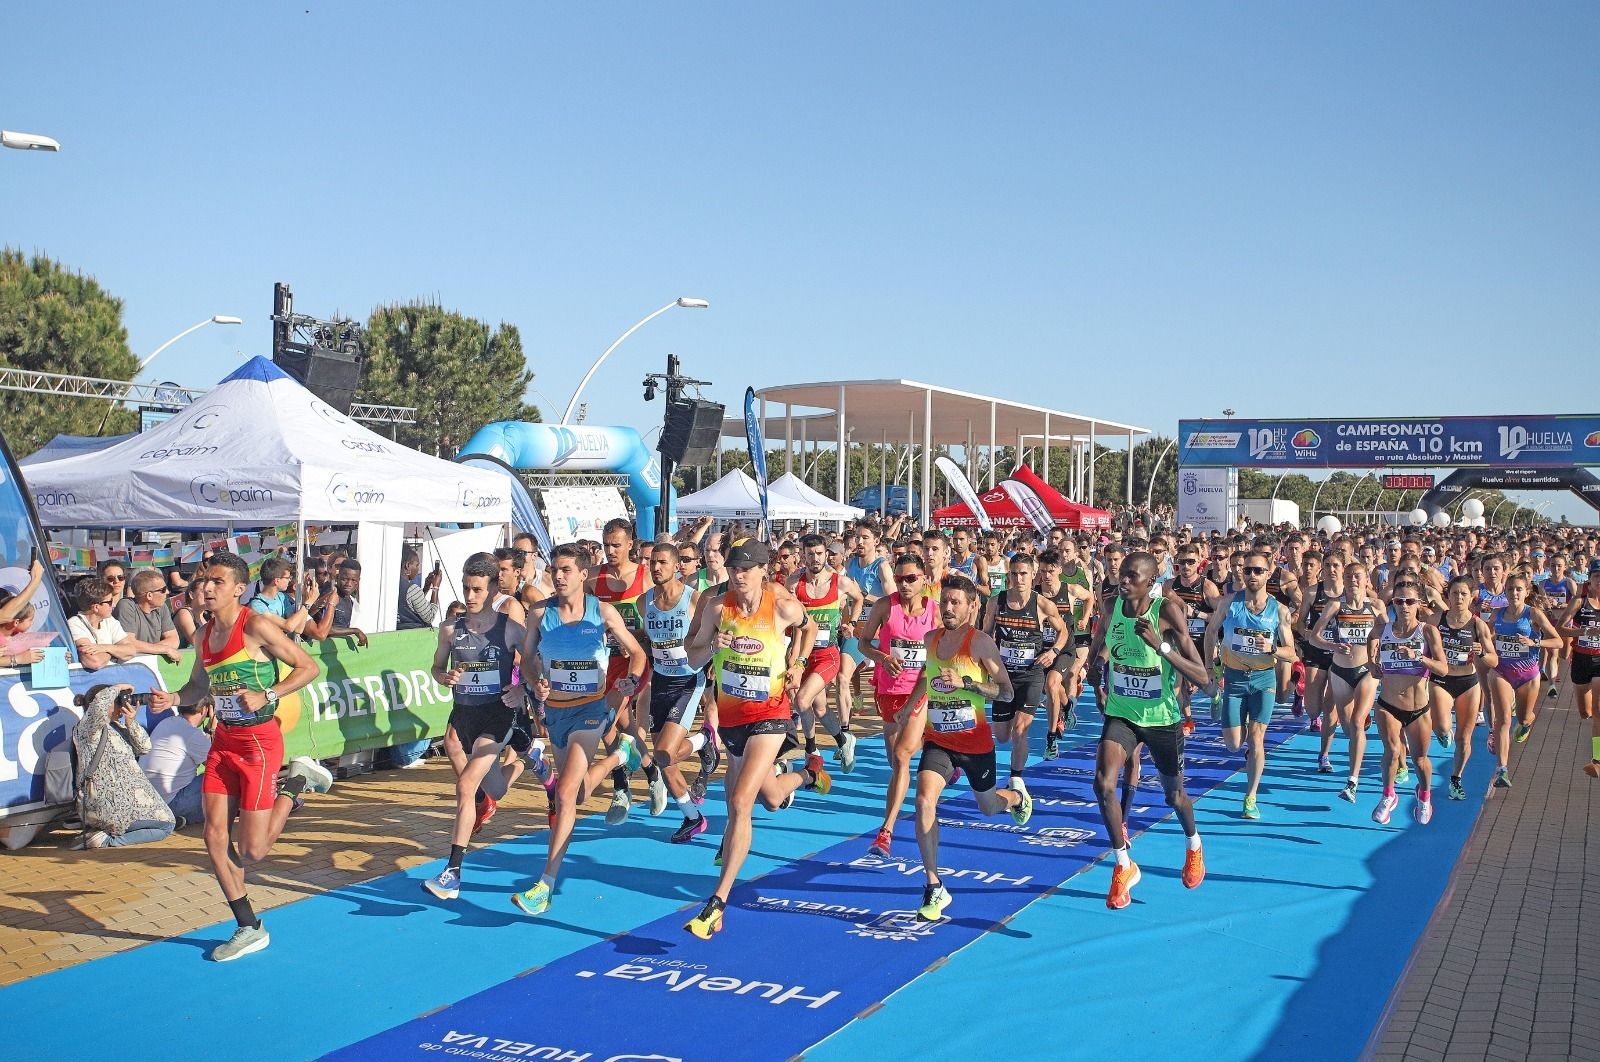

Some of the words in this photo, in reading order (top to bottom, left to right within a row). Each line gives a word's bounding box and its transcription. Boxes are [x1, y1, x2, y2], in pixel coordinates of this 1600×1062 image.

[1336, 423, 1444, 436] CAMPEONATO
[1336, 441, 1352, 451] de
[1356, 438, 1409, 451] ESPAÑA
[1418, 437, 1443, 452] 10
[1450, 436, 1483, 452] km
[1526, 432, 1573, 445] HUELVA
[140, 445, 218, 460] cepaim
[648, 616, 684, 632] nerja
[1348, 629, 1366, 637] 401
[731, 640, 762, 651] Serrano
[1248, 637, 1254, 646] 9
[1501, 643, 1520, 652] 426
[662, 651, 669, 660] 5
[903, 650, 918, 660] 27
[471, 673, 480, 684] 4
[569, 671, 578, 683] 8
[740, 676, 748, 688] 2
[1123, 677, 1149, 689] 107
[220, 698, 233, 709] 23
[941, 711, 956, 722] 22
[756, 896, 871, 915] HUELVA
[630, 956, 709, 971] original
[442, 1030, 593, 1062] HUELVA
